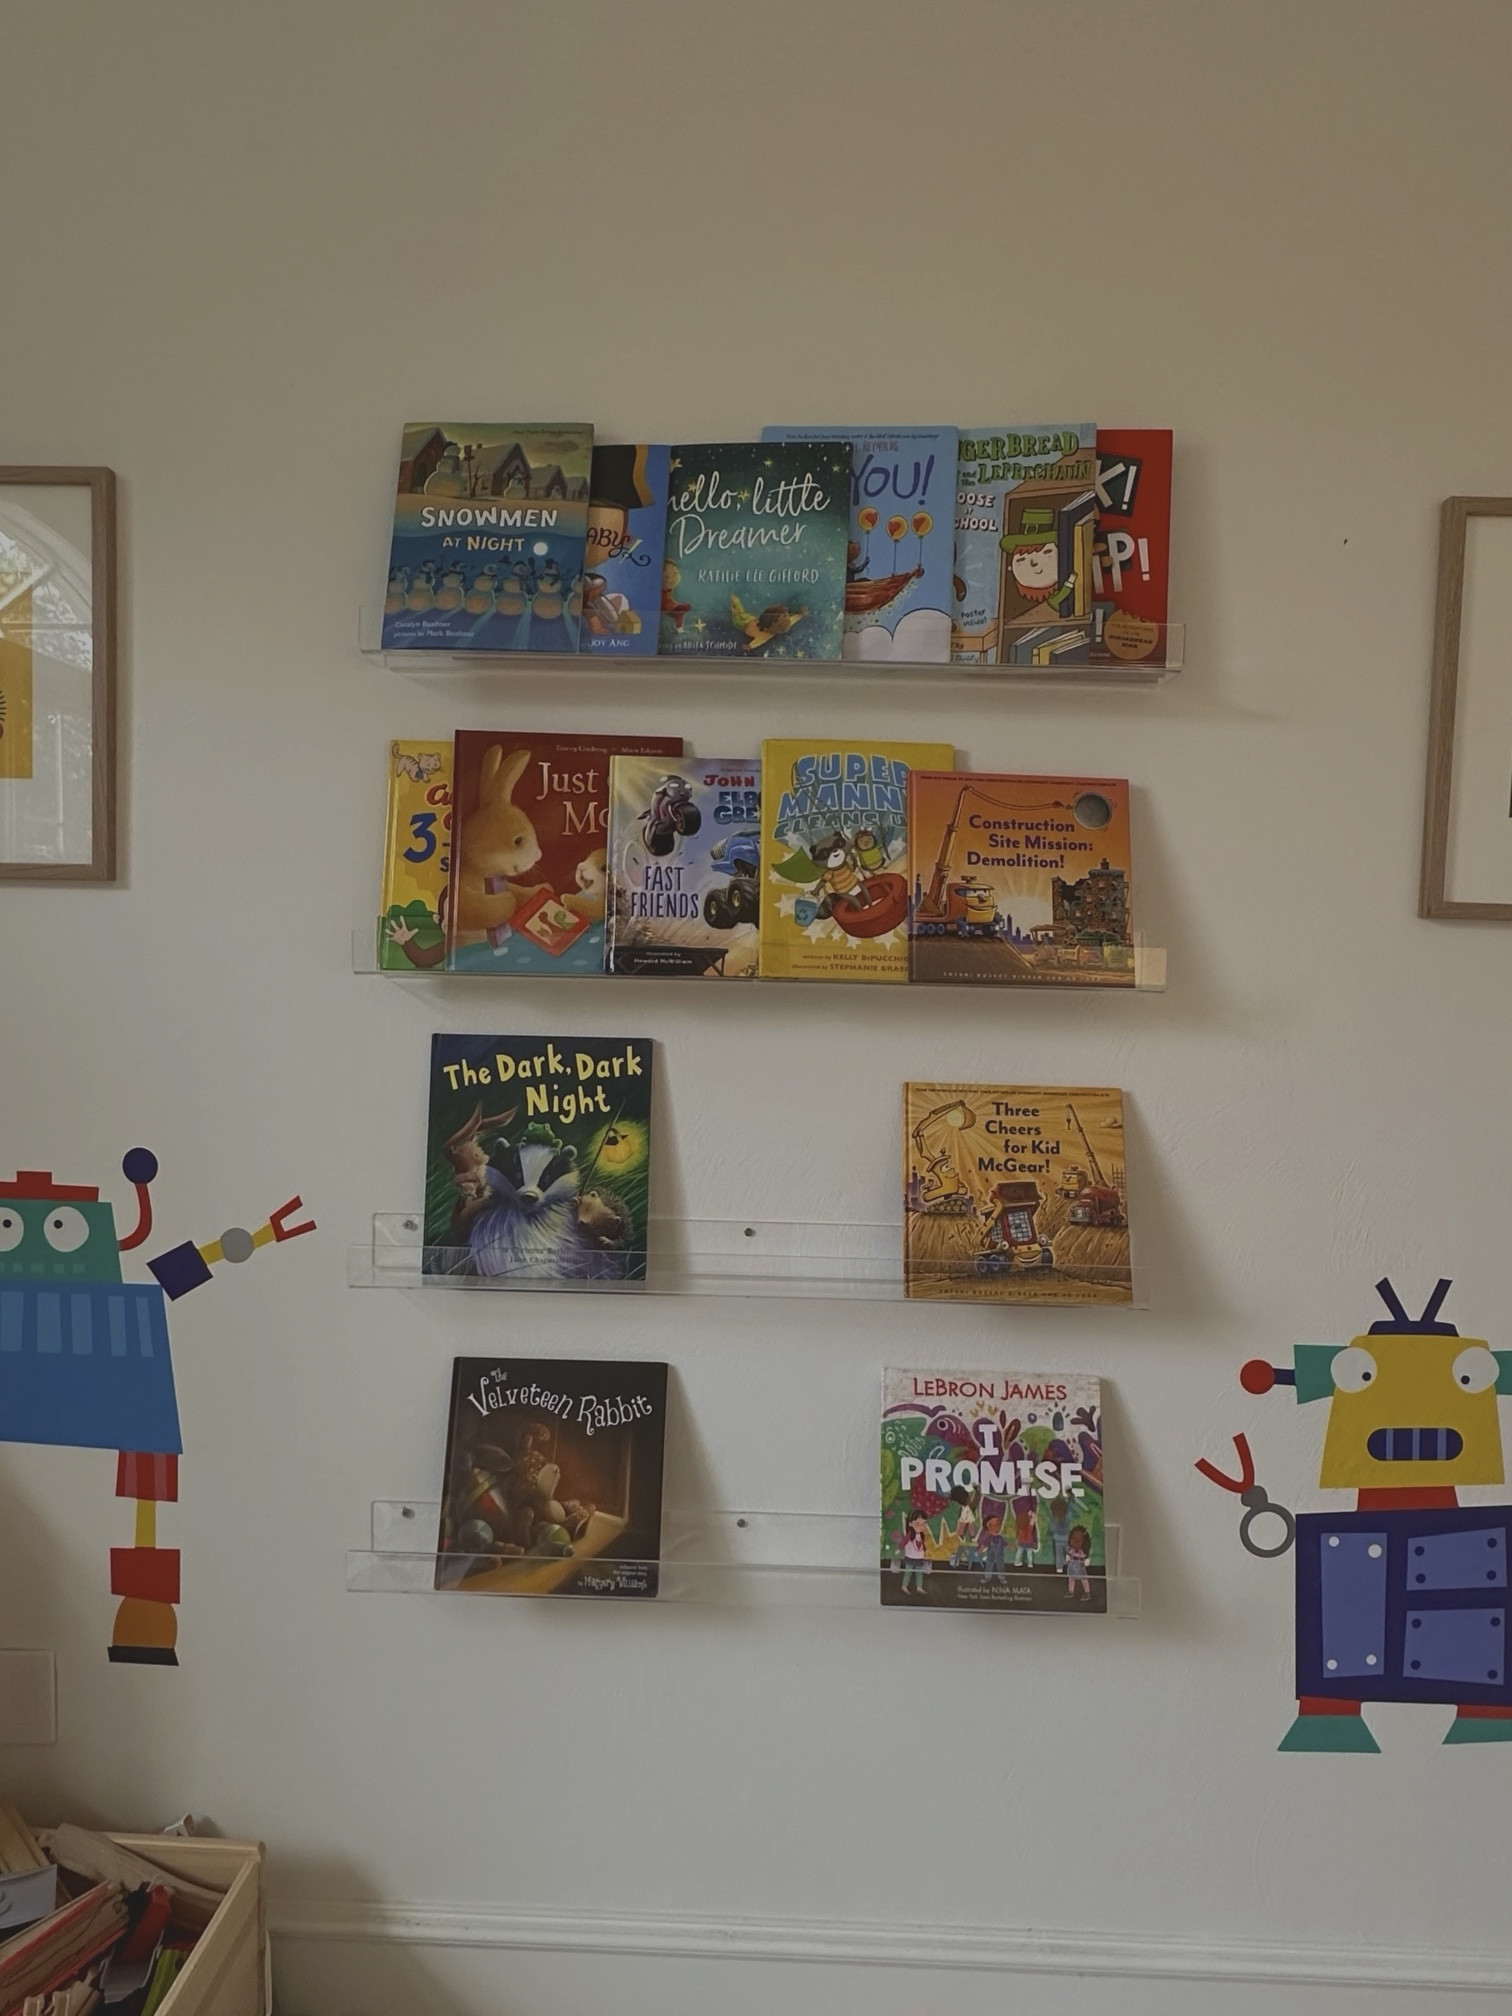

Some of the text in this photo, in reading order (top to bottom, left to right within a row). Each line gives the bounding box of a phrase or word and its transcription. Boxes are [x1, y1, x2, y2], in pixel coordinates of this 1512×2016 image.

[958, 431, 1079, 461] GERBREAD
[852, 454, 935, 506] YOU!
[978, 460, 1092, 484] LEPRECHAUN
[752, 472, 832, 517] little
[421, 506, 558, 528] SNOWMEN
[442, 535, 526, 552] AT NIGHT
[669, 514, 807, 559] Dreamer
[536, 761, 599, 800] Just
[703, 774, 755, 788] JOHN
[777, 782, 907, 820] MANN
[772, 811, 880, 840] CLEANS
[968, 814, 1075, 832] Construction
[988, 833, 1094, 851] Site Mission:
[967, 851, 1065, 869] Demolition!
[644, 866, 685, 891] FAST
[631, 892, 699, 919] FRIENDS
[830, 963, 878, 971] STEPHANIE
[833, 953, 859, 961] KELLY
[443, 1043, 643, 1090] The Dark, Dark
[526, 1084, 611, 1124] Night
[991, 1101, 1040, 1117] Three
[985, 1120, 1042, 1136] Cheers
[1004, 1139, 1060, 1155] for Kid
[978, 1157, 1051, 1174] McGear!
[490, 1367, 508, 1382] The
[1001, 1380, 1067, 1400] JAMES
[467, 1376, 652, 1436] Velveteen Rabbit
[978, 1424, 999, 1456] I
[900, 1457, 1085, 1499] PROMISE
